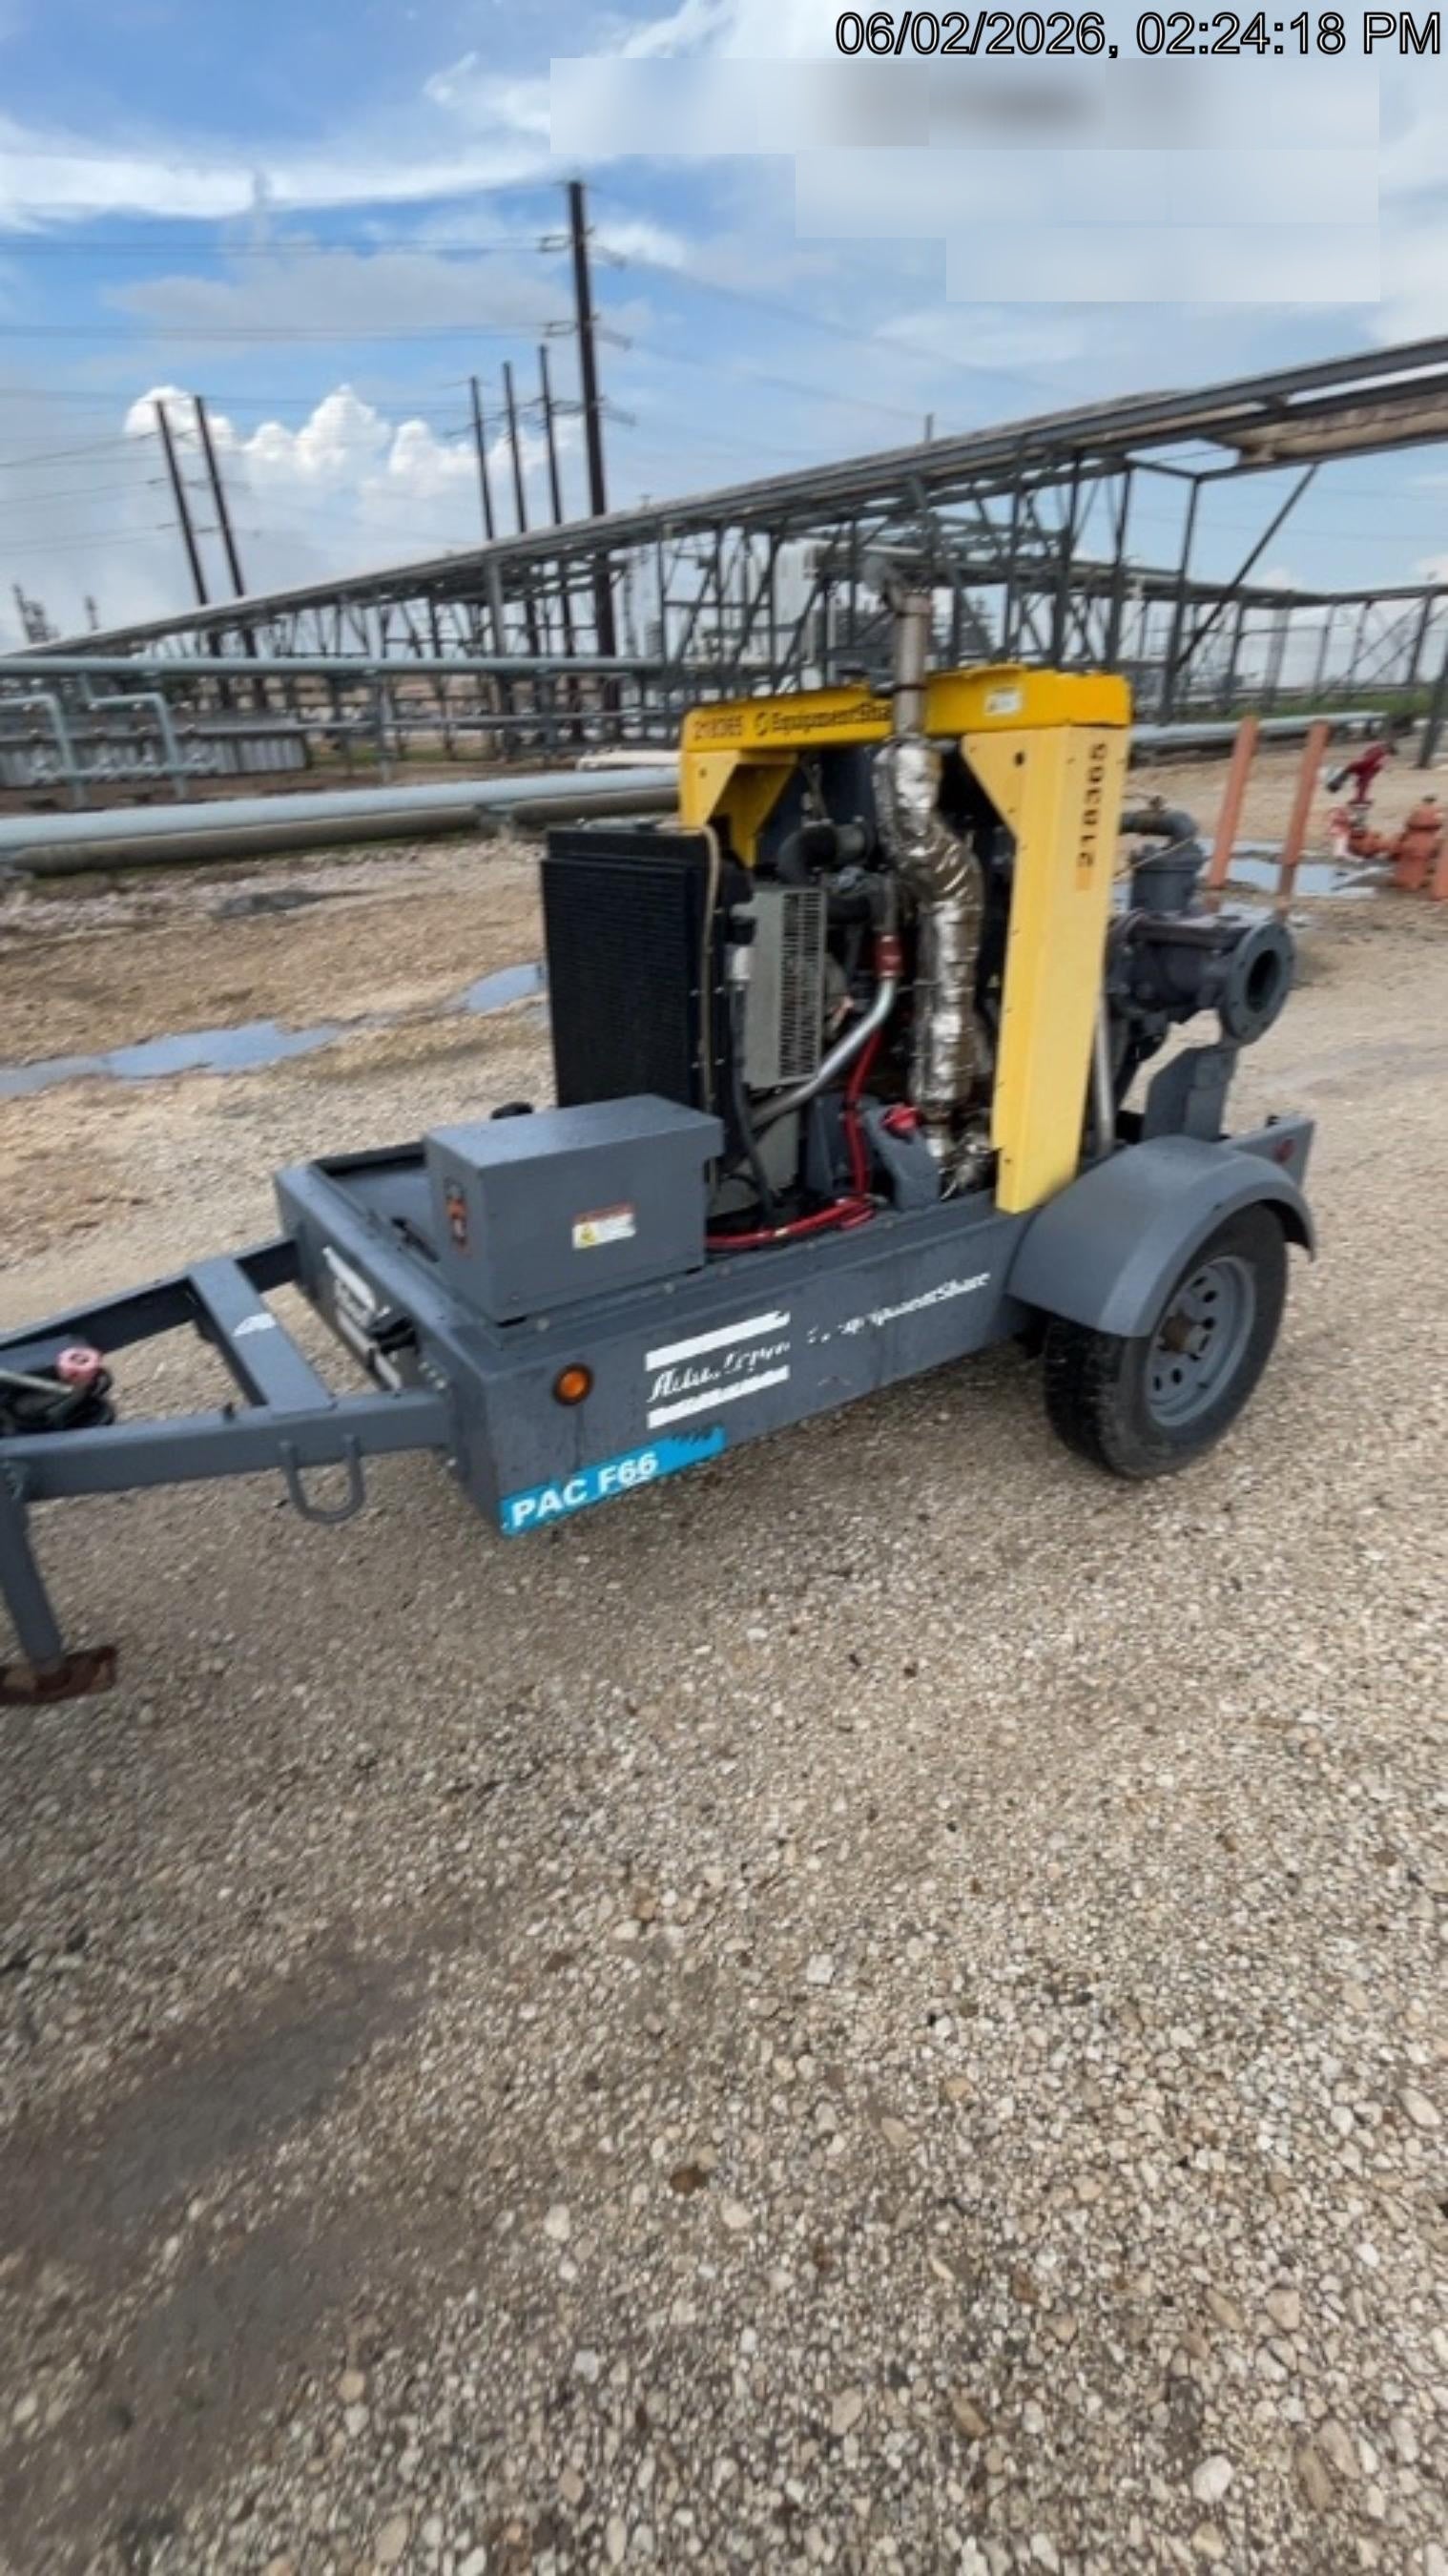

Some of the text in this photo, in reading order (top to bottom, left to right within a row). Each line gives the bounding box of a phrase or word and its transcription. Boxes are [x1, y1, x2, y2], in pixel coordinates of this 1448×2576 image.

[772, 702, 894, 736] EquipmentSha
[1077, 742, 1107, 867] 218365
[510, 1450, 658, 1527] PAC F66
